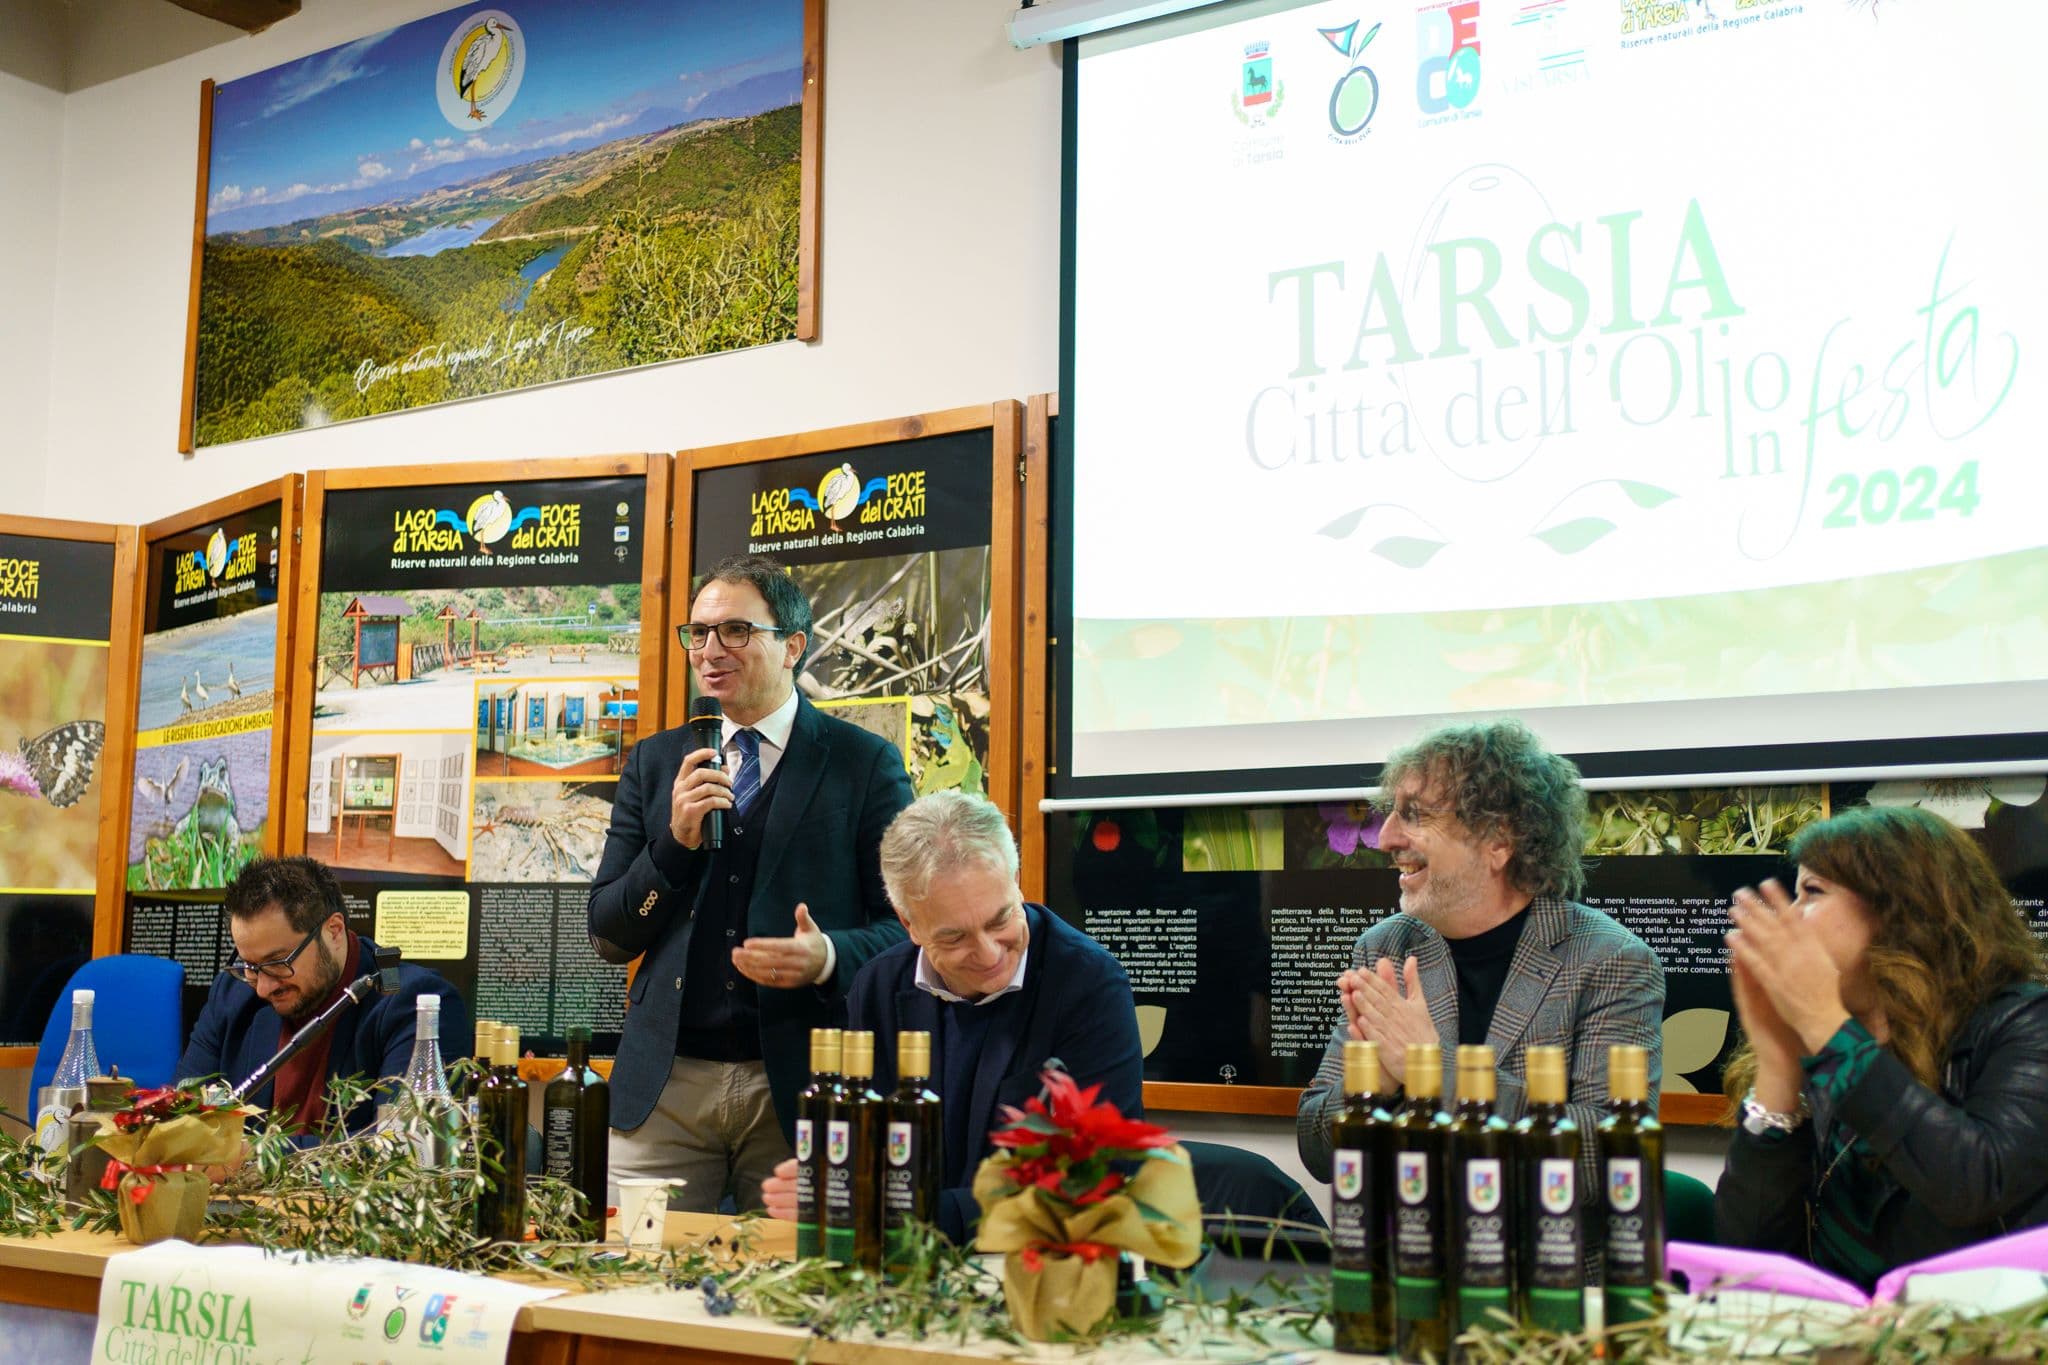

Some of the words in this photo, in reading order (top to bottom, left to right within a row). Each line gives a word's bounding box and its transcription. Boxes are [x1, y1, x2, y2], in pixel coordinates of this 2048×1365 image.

[1621, 37, 1654, 49] Riserve
[1657, 29, 1693, 42] naturali
[1697, 24, 1719, 34] della
[1723, 15, 1760, 29] Regione
[1764, 6, 1803, 20] Calabria
[1636, 4, 1689, 31] TARSIA
[1268, 197, 1747, 380] TARSIA
[1737, 223, 2022, 561] festa
[1245, 372, 1417, 472] Città
[887, 471, 926, 497] FOCE
[1822, 460, 1983, 530] 2024
[540, 504, 580, 526] FOCE
[752, 488, 789, 515] LAGO
[861, 502, 881, 524] del
[883, 495, 925, 521] CRATI
[395, 509, 436, 531] LAGO
[751, 517, 764, 537] di
[765, 508, 815, 534] TARSIA
[239, 533, 256, 556] FOCE
[393, 533, 406, 553] di
[409, 530, 463, 551] TARSIA
[512, 530, 534, 549] del
[536, 525, 580, 548] CRATI
[749, 542, 781, 553] Riserve
[784, 537, 819, 550] naturali
[822, 534, 843, 546] della
[847, 531, 883, 544] Regione
[887, 524, 924, 538] Calabria
[0, 559, 39, 579] FOCE
[176, 551, 194, 575] LAGO
[226, 559, 236, 580] del
[237, 553, 256, 577] CRATI
[391, 558, 426, 568] Riserve
[429, 556, 467, 567] naturali
[470, 555, 494, 566] della
[497, 554, 536, 567] Regione
[539, 553, 578, 565] Calabria
[175, 575, 181, 594] di
[183, 568, 205, 592] TARSIA
[0, 601, 36, 614] alabria
[163, 729, 169, 743] LE
[196, 725, 198, 738] E
[244, 712, 272, 729] AMBIENTA
[1630, 897, 1677, 905] interessante,
[1688, 947, 1711, 955] spesso
[120, 1280, 256, 1347] TARSIA
[166, 1336, 263, 1365] dell'Ol
